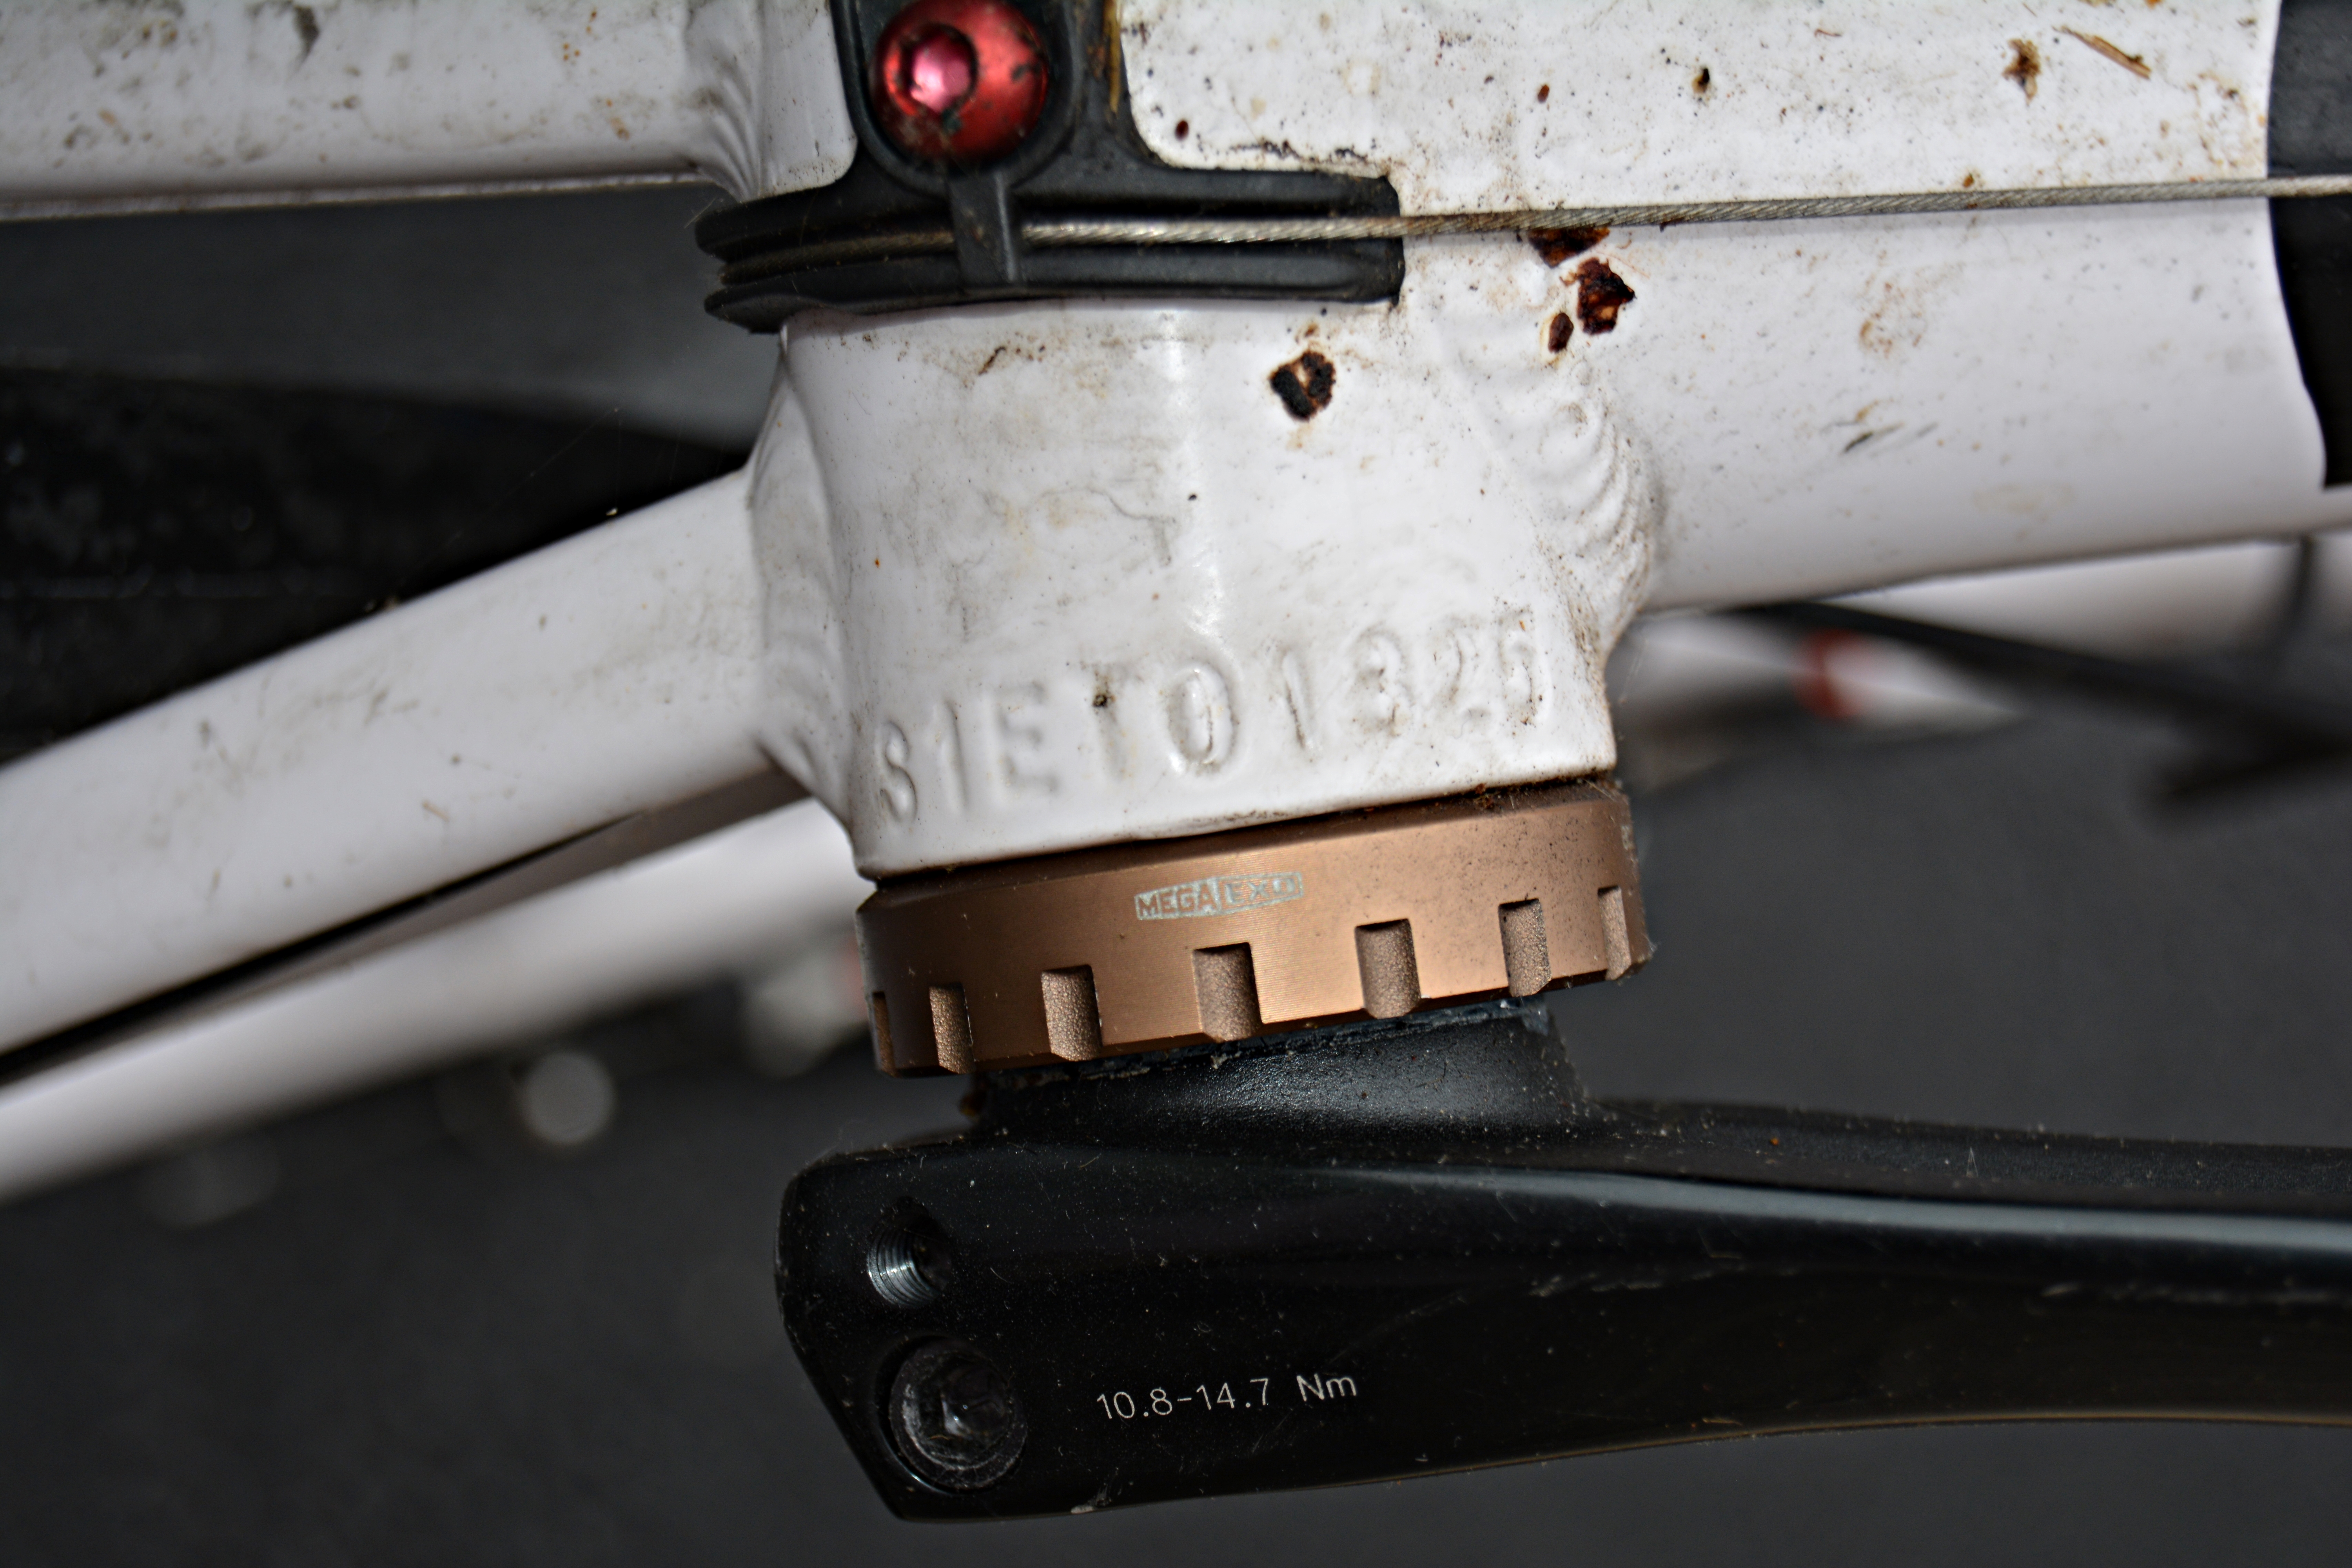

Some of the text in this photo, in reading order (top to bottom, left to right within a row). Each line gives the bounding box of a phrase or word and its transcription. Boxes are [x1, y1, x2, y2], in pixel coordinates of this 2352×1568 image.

[1138, 878, 1294, 916] MEGA EXO
[1096, 1373, 1357, 1419] 10.8-14.7 Nm
